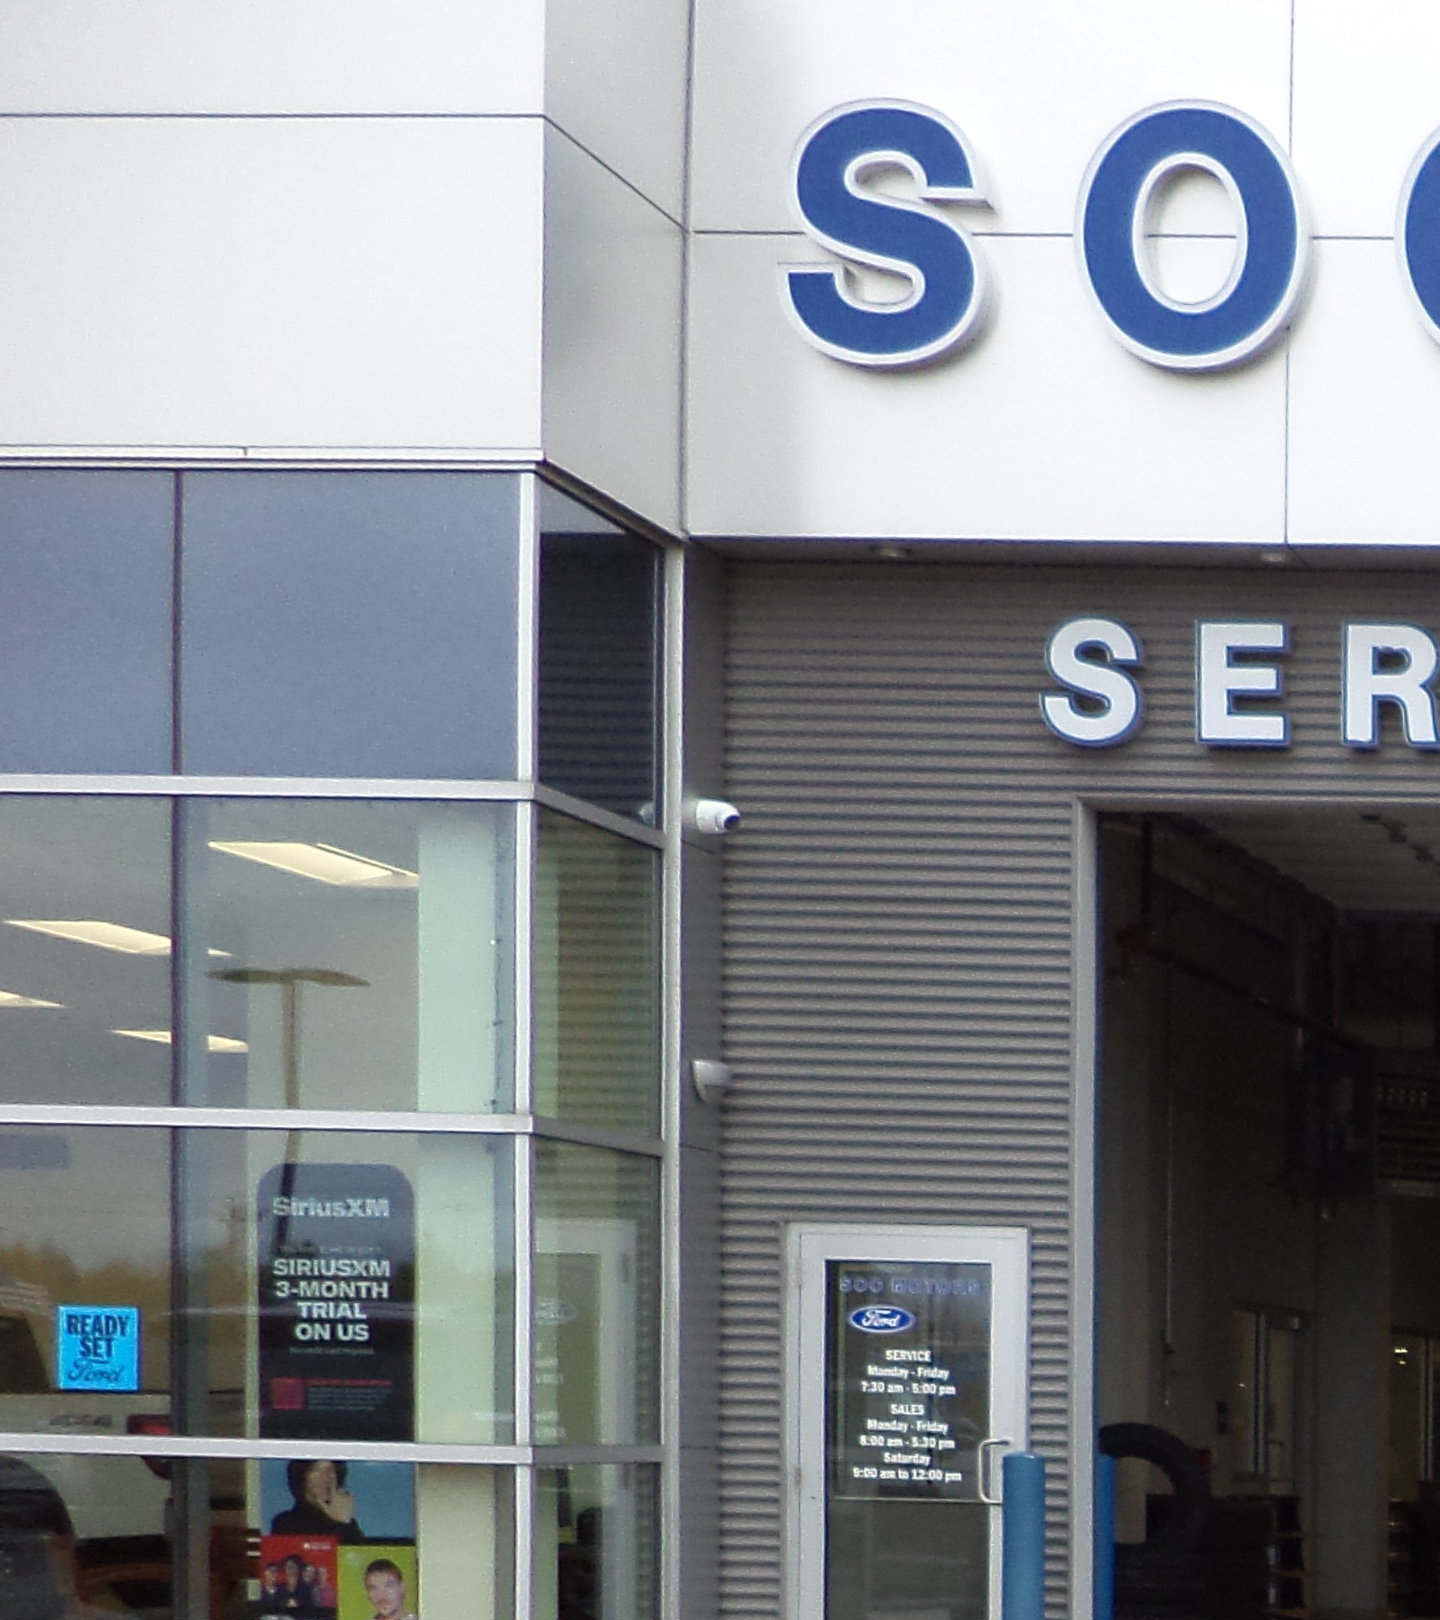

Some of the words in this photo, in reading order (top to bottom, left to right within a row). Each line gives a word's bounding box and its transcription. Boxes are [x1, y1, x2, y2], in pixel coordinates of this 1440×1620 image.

[272, 1197, 390, 1218] SiriusXM
[273, 1258, 391, 1277] SIRIUSXM
[275, 1281, 389, 1299] 3-MONTH
[296, 1301, 368, 1320] TRIAL
[861, 1309, 901, 1328] Ford
[67, 1313, 129, 1337] READY
[294, 1323, 332, 1342] ON
[336, 1323, 371, 1342] US
[80, 1336, 114, 1358] SET
[885, 1349, 932, 1362] SERVICE
[68, 1358, 125, 1382] Ford
[867, 1364, 909, 1380] Monday
[917, 1366, 950, 1381] Friday
[890, 1403, 925, 1416] SALES
[866, 1418, 909, 1433] Monday
[916, 1420, 949, 1435] Friday
[883, 1452, 932, 1467] Saturday
